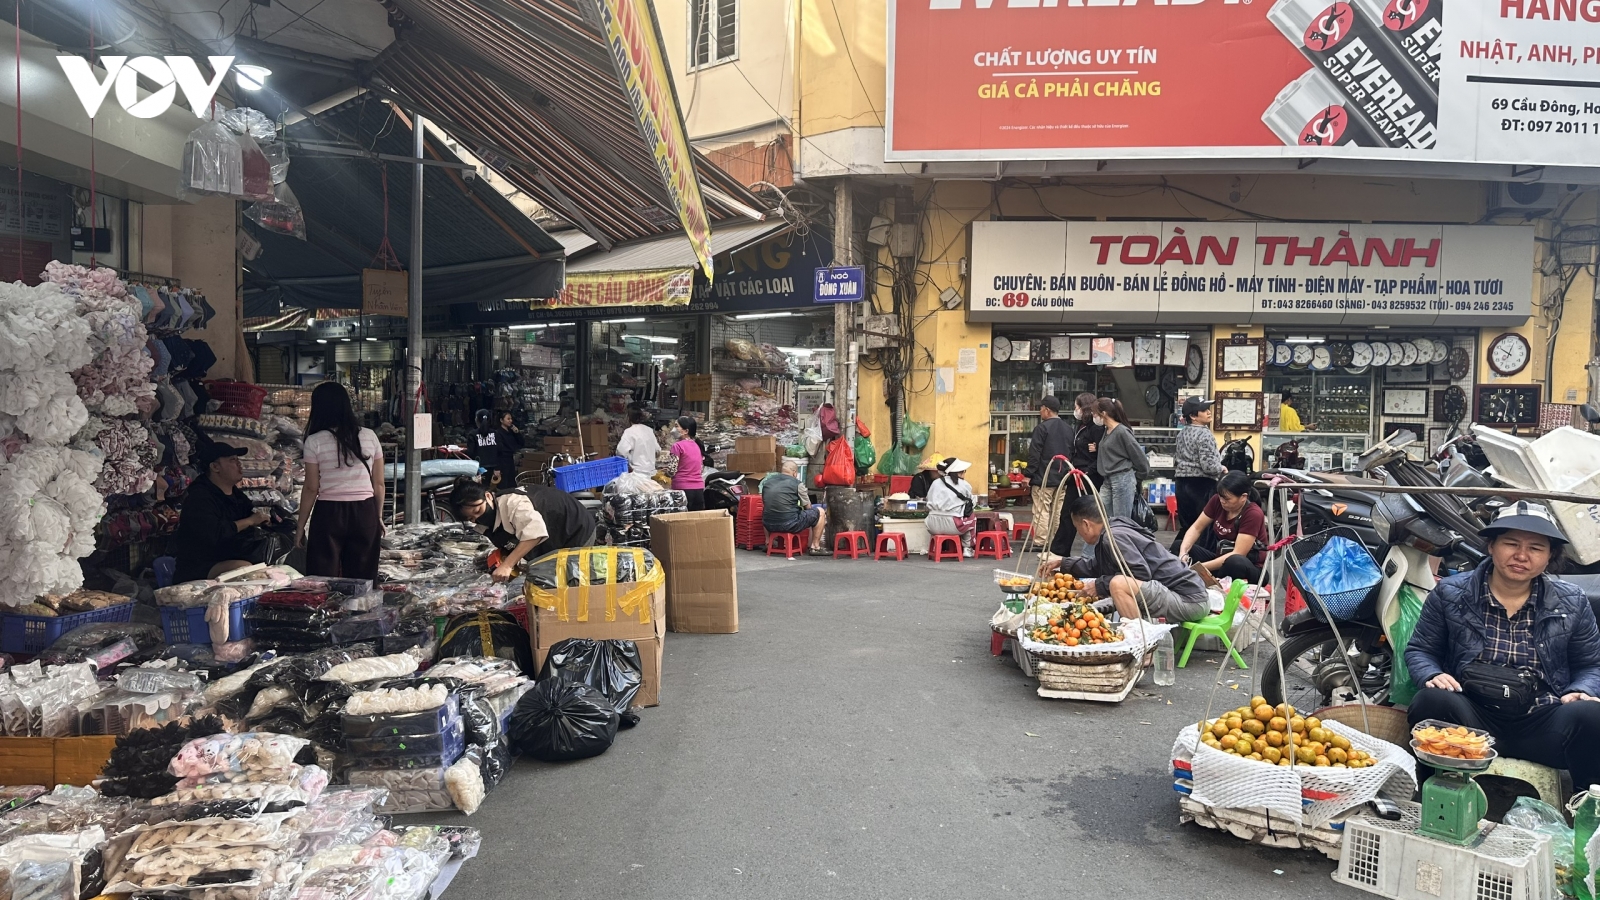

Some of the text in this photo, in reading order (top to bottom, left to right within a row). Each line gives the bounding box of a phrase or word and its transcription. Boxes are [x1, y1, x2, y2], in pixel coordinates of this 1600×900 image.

[973, 46, 1157, 69] CHẤT LƯỢNG UY TÍN
[1460, 38, 1522, 65] NHẬT,
[1527, 44, 1577, 66] ANH,
[977, 77, 1161, 99] GIÁ CẢ PHẢI CHĂNG
[1322, 56, 1403, 142] SUPER HEAVY
[1491, 98, 1508, 110] 69
[1511, 97, 1537, 112] Cầu
[1540, 100, 1580, 116] Đông,
[1501, 119, 1524, 131] ĐT:
[1527, 120, 1552, 132] 097
[1555, 121, 1587, 134] 2011
[1089, 226, 1441, 267] TOÀN THÀNH
[577, 283, 593, 305] 65
[739, 276, 763, 296] CÁC
[766, 276, 795, 297] LOẠI
[993, 273, 1047, 291] CHUYÊN:
[1050, 273, 1076, 291] BÁN
[1080, 273, 1115, 291] BUÔN
[1123, 273, 1149, 291] BÁN
[1153, 270, 1168, 292] LẺ
[1171, 270, 1206, 292] ĐỒNG
[1209, 271, 1226, 292] HỒ
[1236, 275, 1263, 293] MÁY
[1267, 275, 1296, 293] TÍNH
[1305, 275, 1334, 295] ĐIỆN
[1338, 275, 1365, 294] MÁY
[1374, 279, 1397, 297] TẠP
[1399, 273, 1437, 295] PHẨM
[1446, 280, 1471, 295] HOA
[1474, 279, 1503, 296] TƯƠI
[690, 302, 704, 311] 262
[704, 301, 719, 310] 994
[985, 292, 1074, 308] ĐC: 69 CẦU ĐÔNG
[1295, 300, 1333, 309] 8266460
[1335, 297, 1366, 310] (SÁNG)
[1371, 301, 1388, 310] 043
[1389, 301, 1426, 310] 8259532
[1429, 298, 1449, 311] (TỐI)
[1454, 301, 1471, 311] 094
[1473, 301, 1490, 311] 246
[1492, 301, 1514, 311] 2345
[477, 437, 497, 447] BACK
